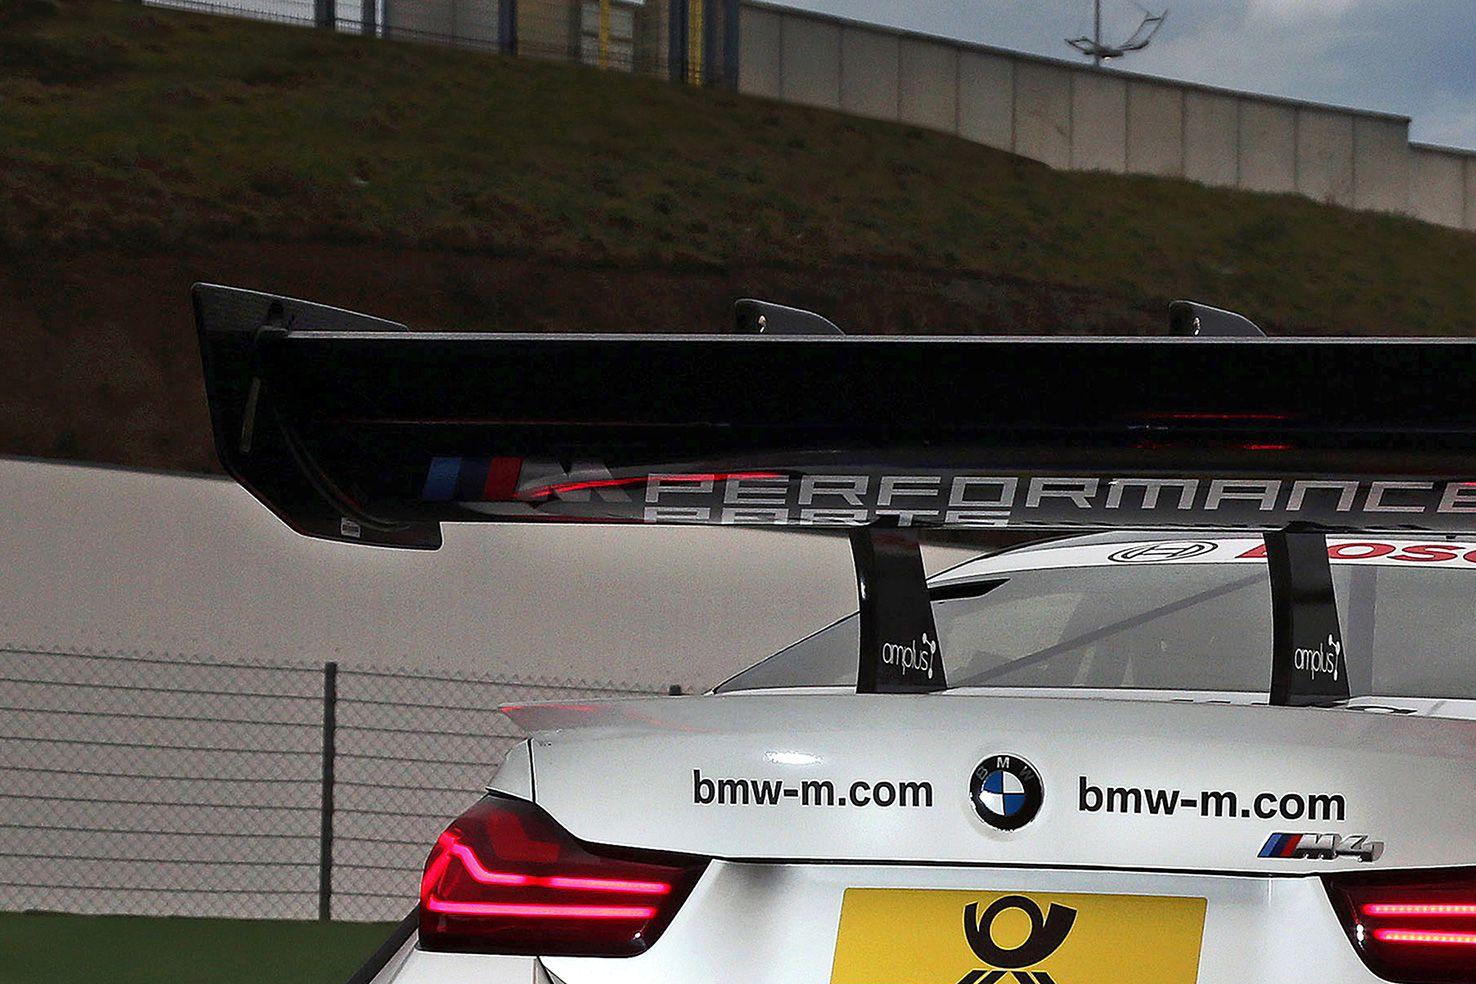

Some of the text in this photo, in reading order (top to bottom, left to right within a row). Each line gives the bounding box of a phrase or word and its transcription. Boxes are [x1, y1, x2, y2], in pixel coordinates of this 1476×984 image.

[692, 769, 933, 808] bmw-m.com
[975, 756, 1035, 782] BMW
[1079, 776, 1346, 820] bmw-m.com
